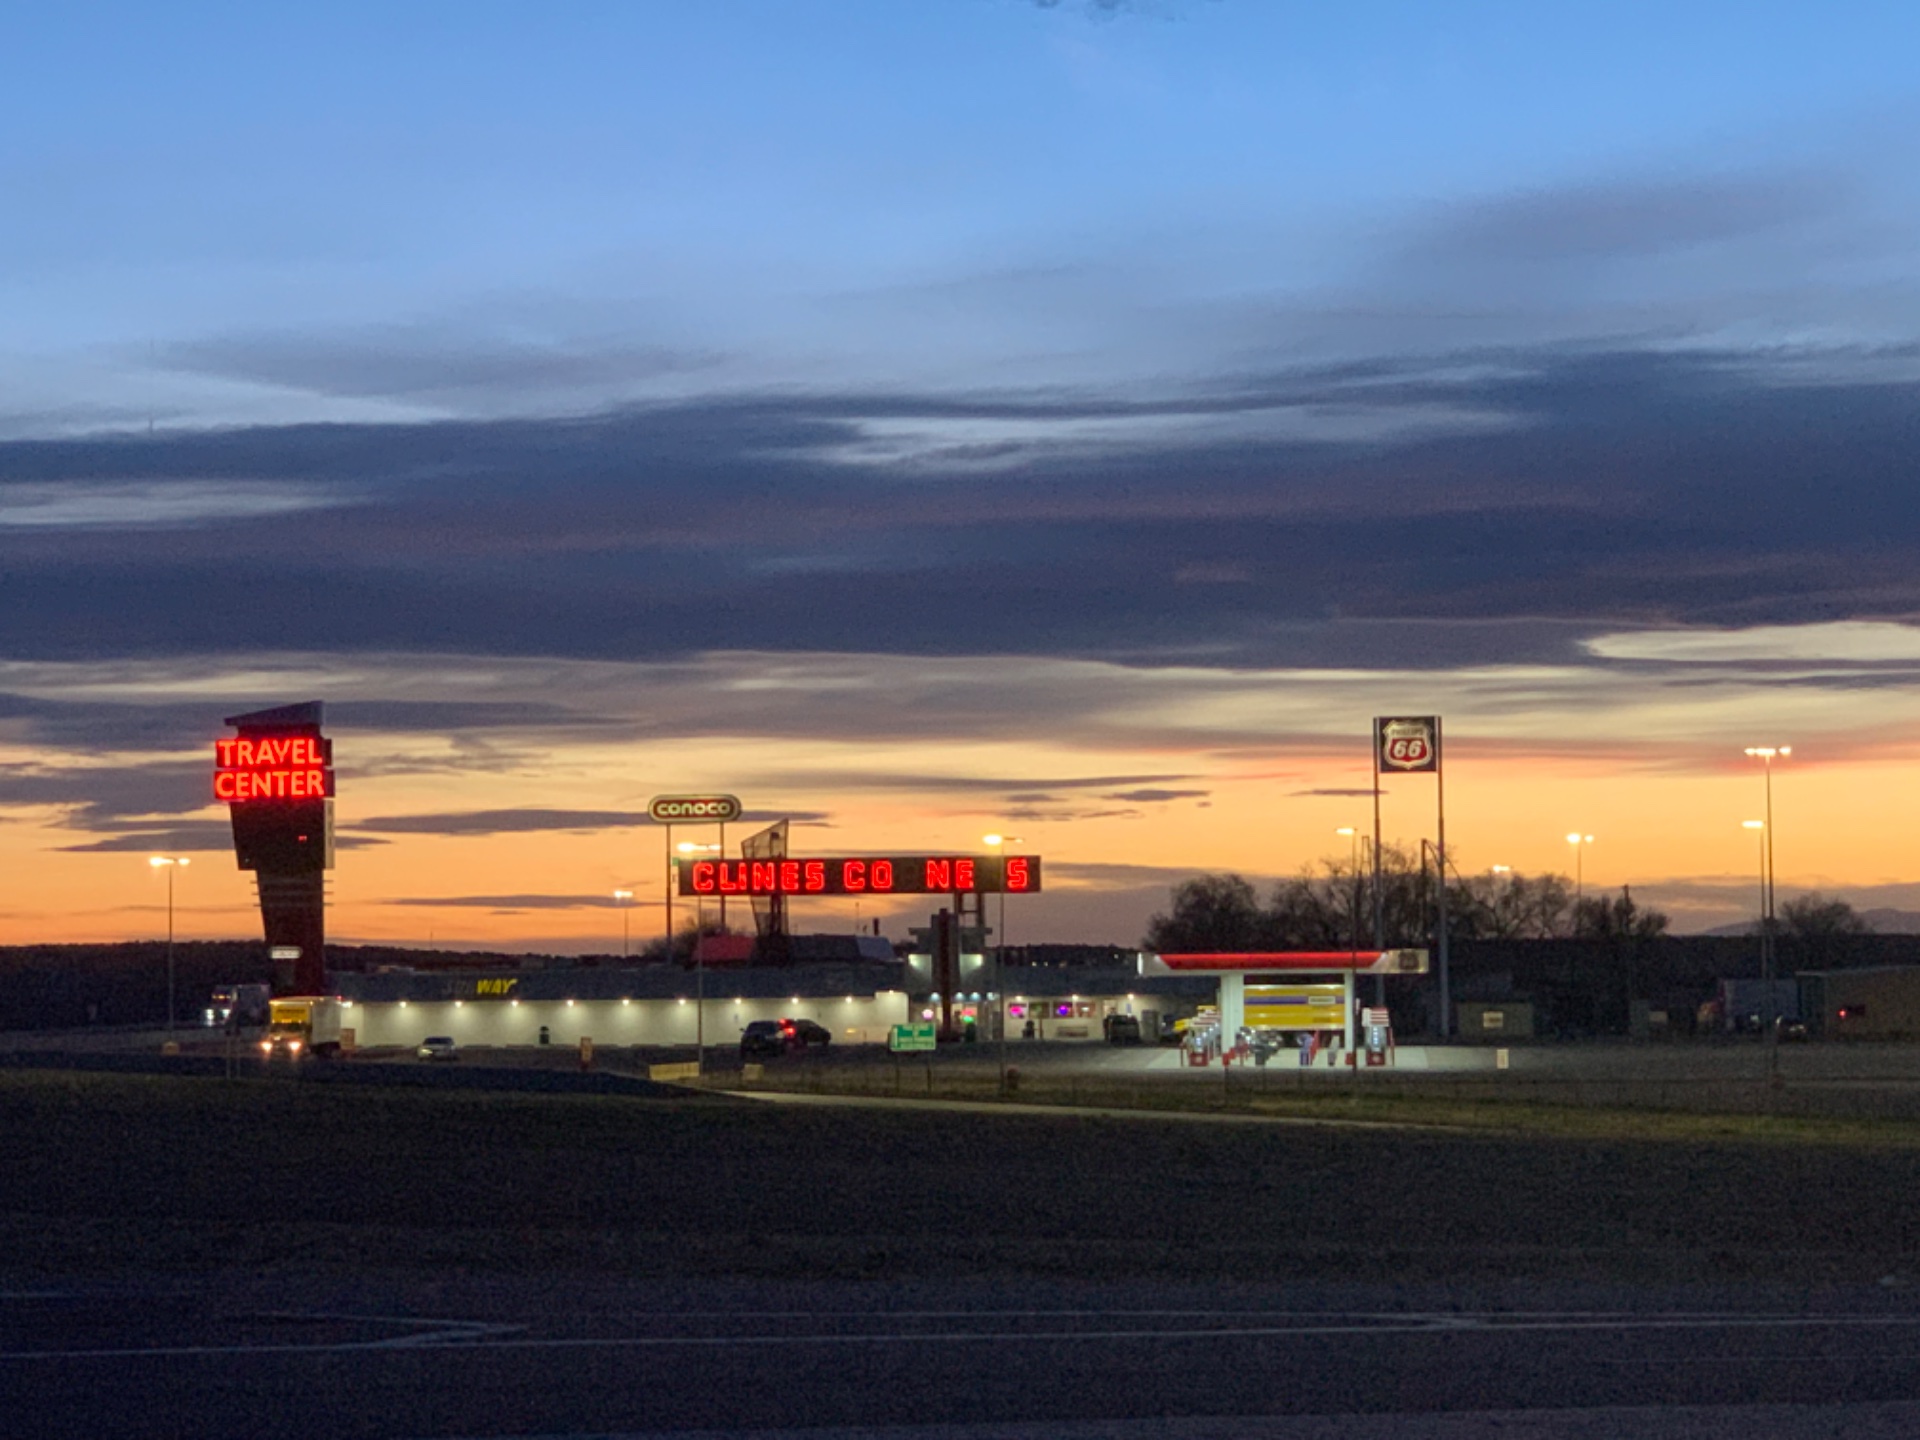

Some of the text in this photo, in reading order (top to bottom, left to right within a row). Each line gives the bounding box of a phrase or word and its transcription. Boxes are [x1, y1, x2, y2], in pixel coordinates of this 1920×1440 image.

[217, 738, 323, 766] TRAVEL
[1393, 739, 1422, 759] 66
[215, 770, 325, 798] CENTER
[692, 860, 826, 892] CLINES
